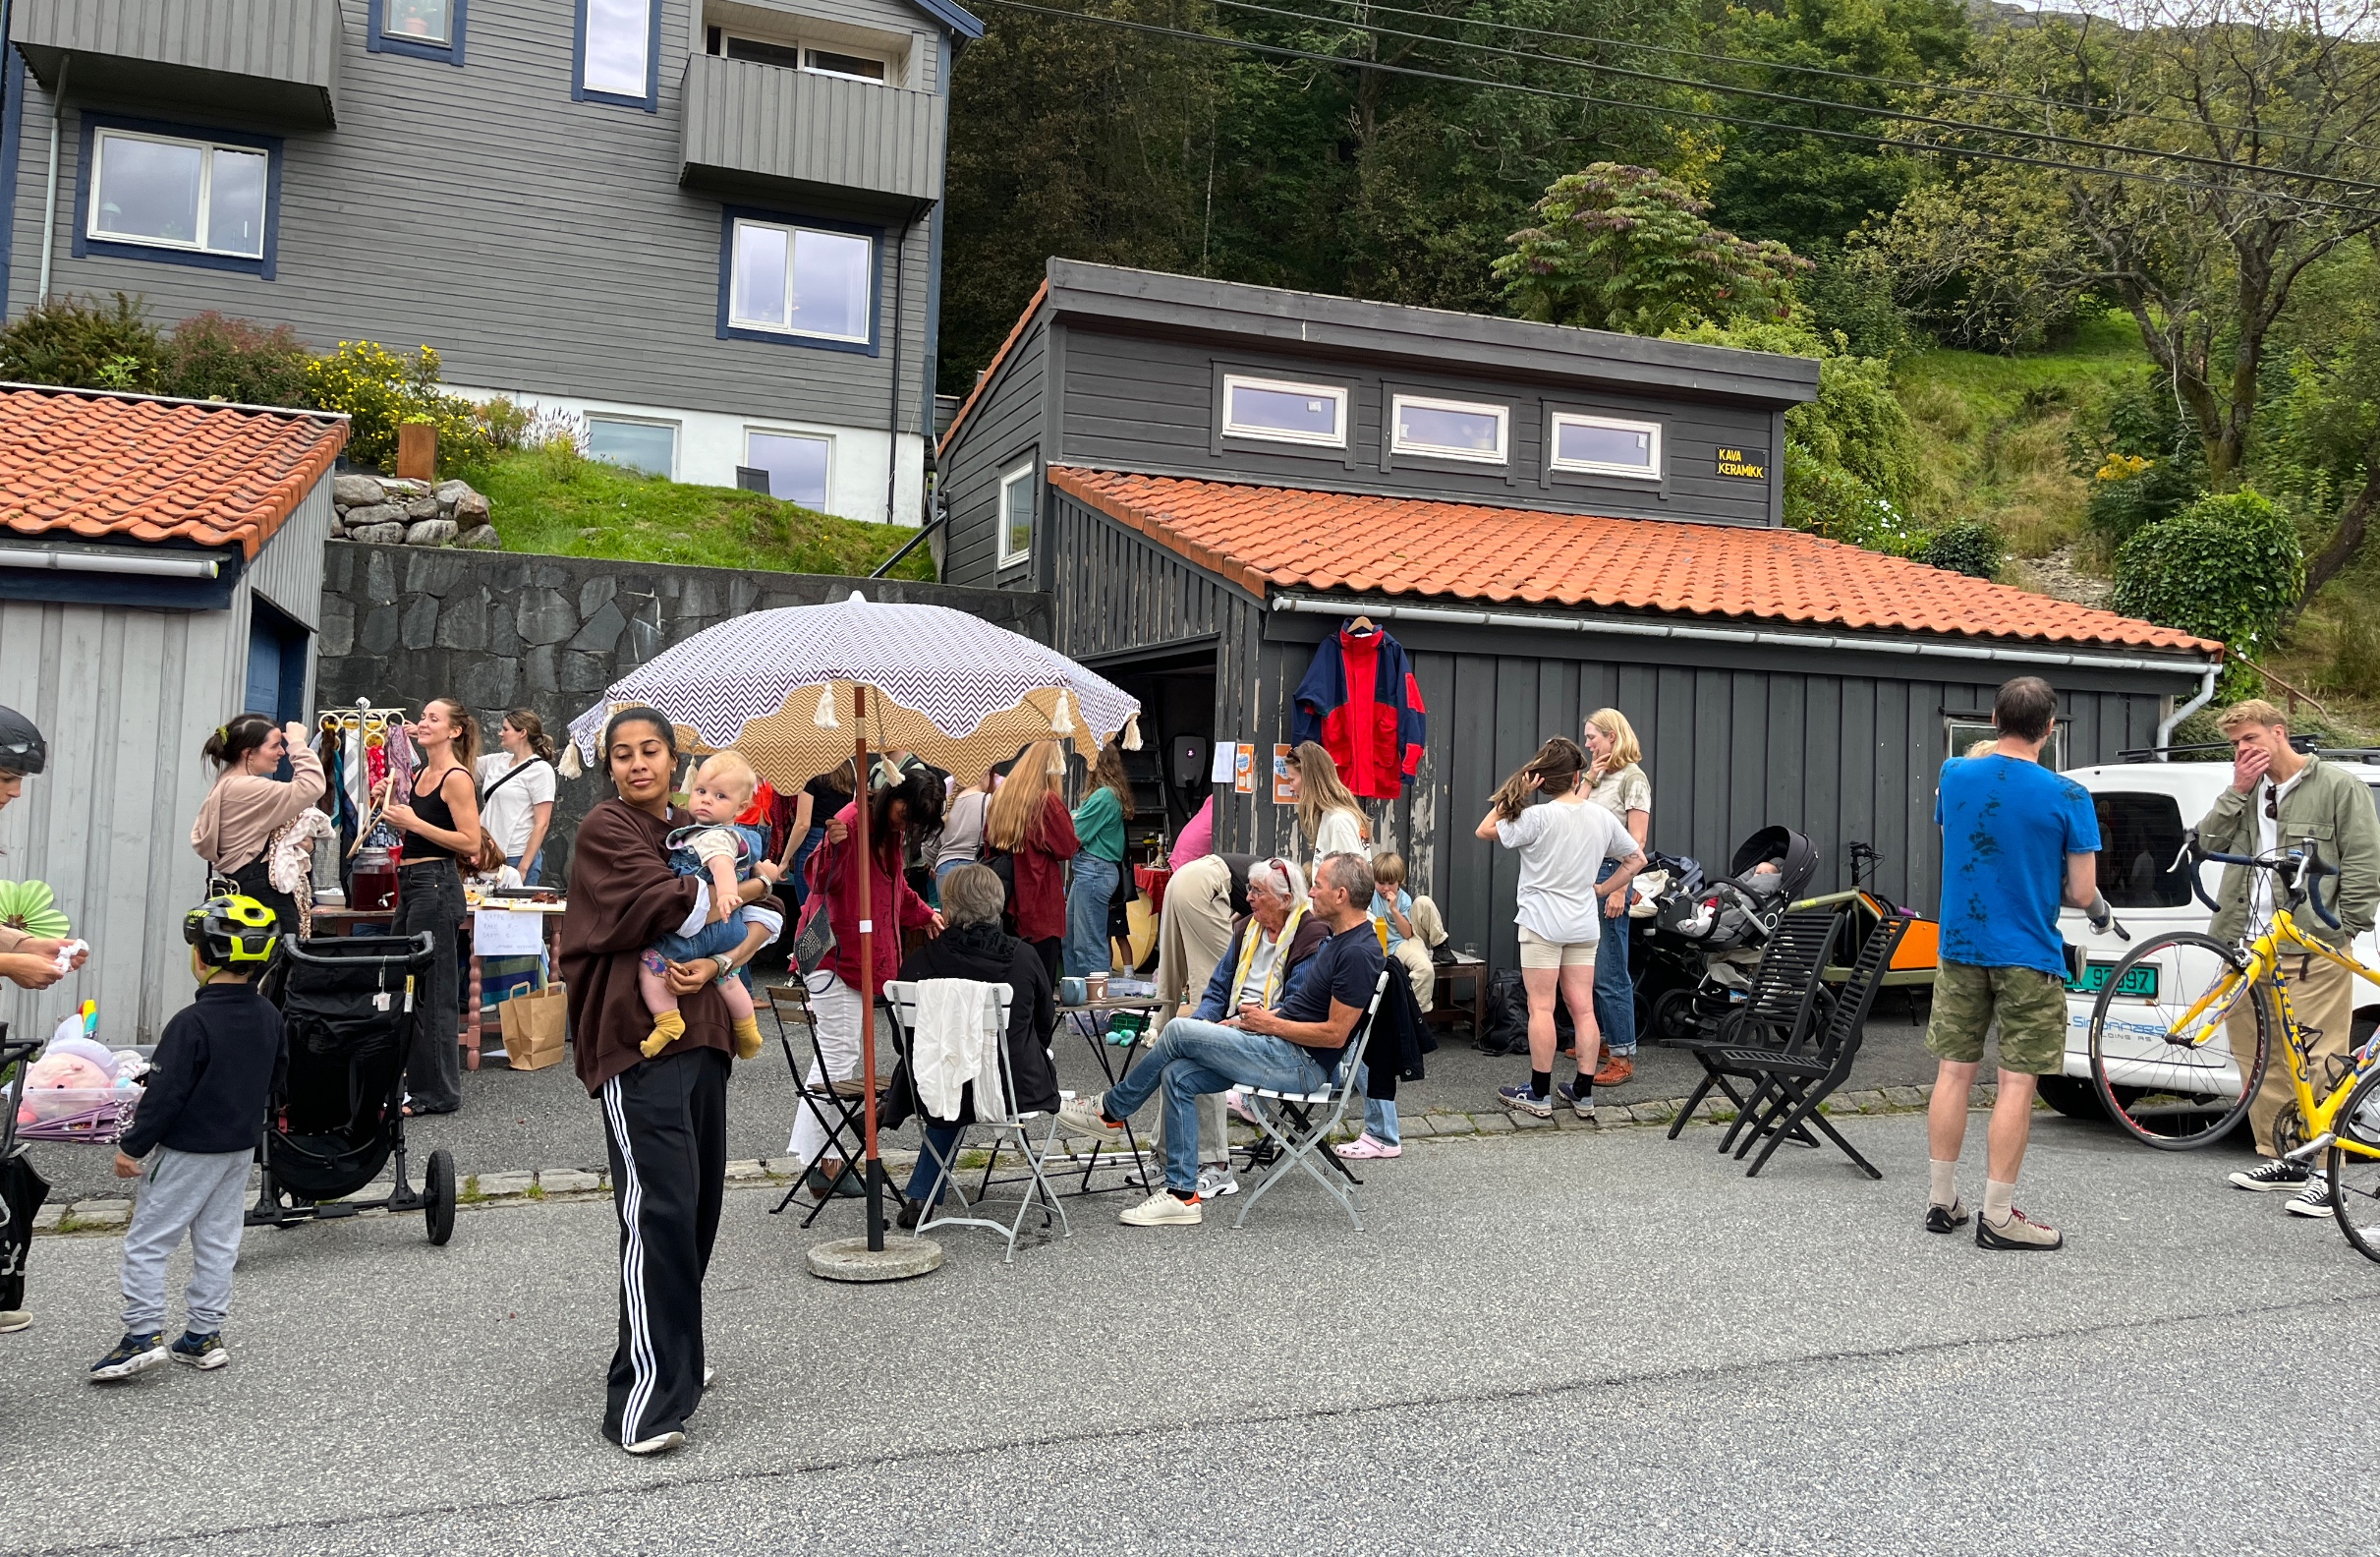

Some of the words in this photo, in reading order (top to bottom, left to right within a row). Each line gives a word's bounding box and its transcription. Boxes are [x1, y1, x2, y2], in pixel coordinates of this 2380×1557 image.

[1719, 448, 1742, 462] KAVA
[1718, 462, 1765, 479] KERAMIKK
[2093, 968, 2149, 990] 997
[2226, 974, 2246, 1001] TREK
[2275, 970, 2301, 1048] TREK
